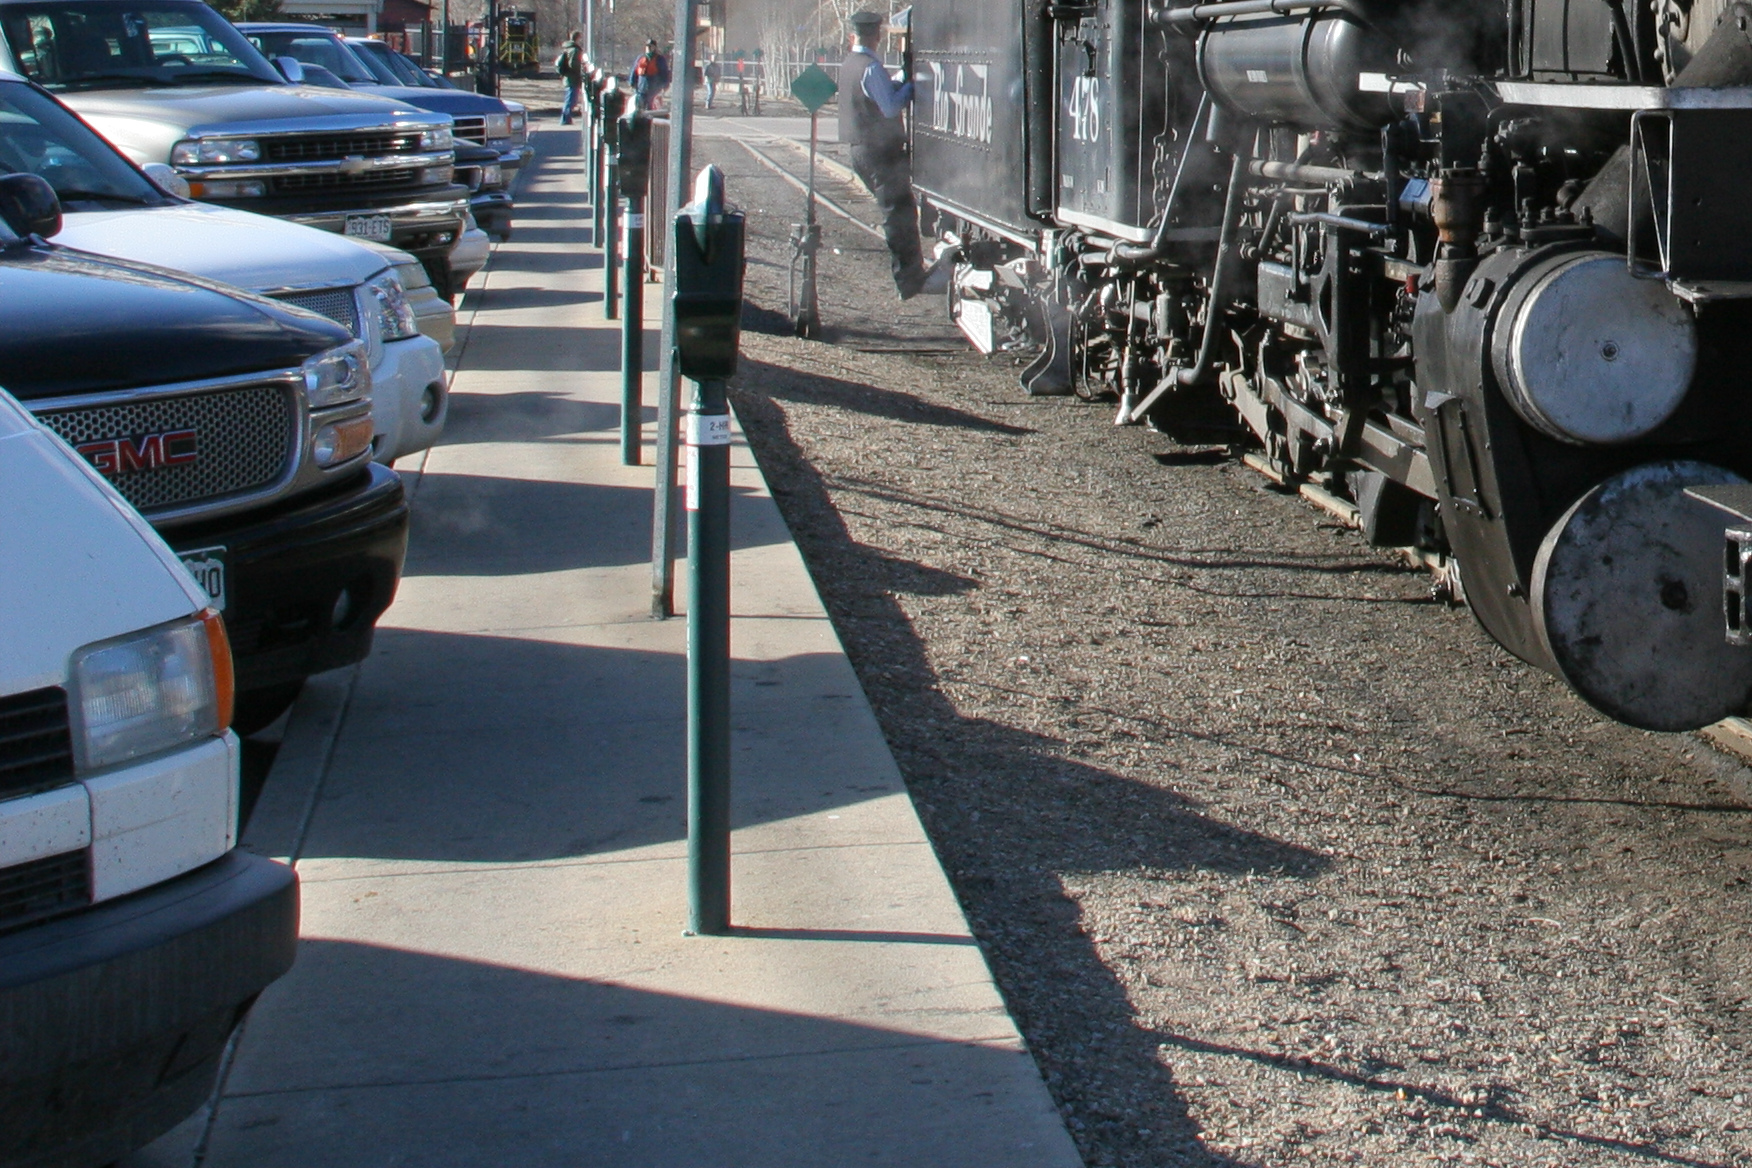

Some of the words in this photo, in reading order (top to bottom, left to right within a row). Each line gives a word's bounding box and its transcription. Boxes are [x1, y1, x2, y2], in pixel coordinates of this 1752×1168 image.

[928, 61, 949, 133] Rio
[949, 63, 993, 144] Grande
[1069, 76, 1099, 143] 478
[75, 429, 198, 473] GMC
